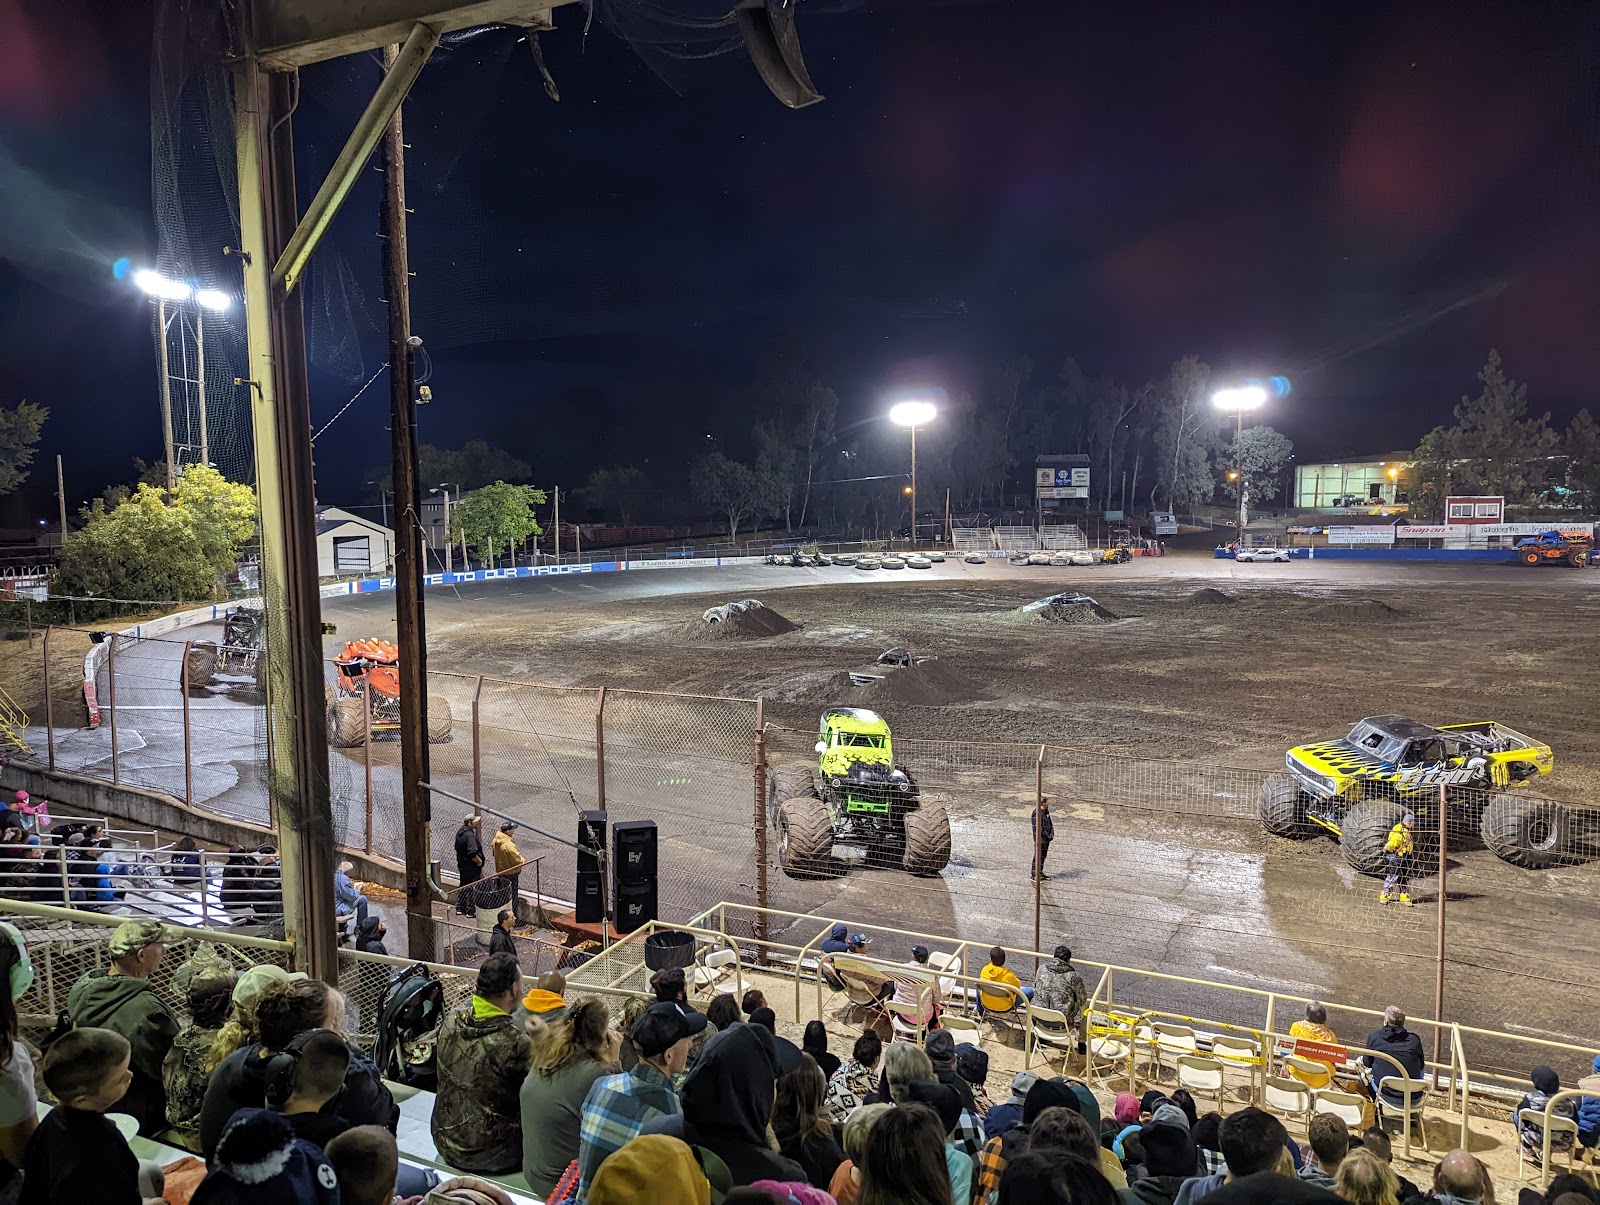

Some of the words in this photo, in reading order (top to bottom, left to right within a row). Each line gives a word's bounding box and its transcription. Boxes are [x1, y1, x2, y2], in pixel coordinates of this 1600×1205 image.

[1401, 526, 1446, 534] Snap-on
[453, 572, 476, 583] TO
[484, 568, 518, 580] OUR
[527, 563, 592, 577] TROOPS
[1395, 762, 1475, 786] Titan
[1296, 1045, 1318, 1053] REYNOLDS
[1318, 1049, 1337, 1057] SYSTEMS
